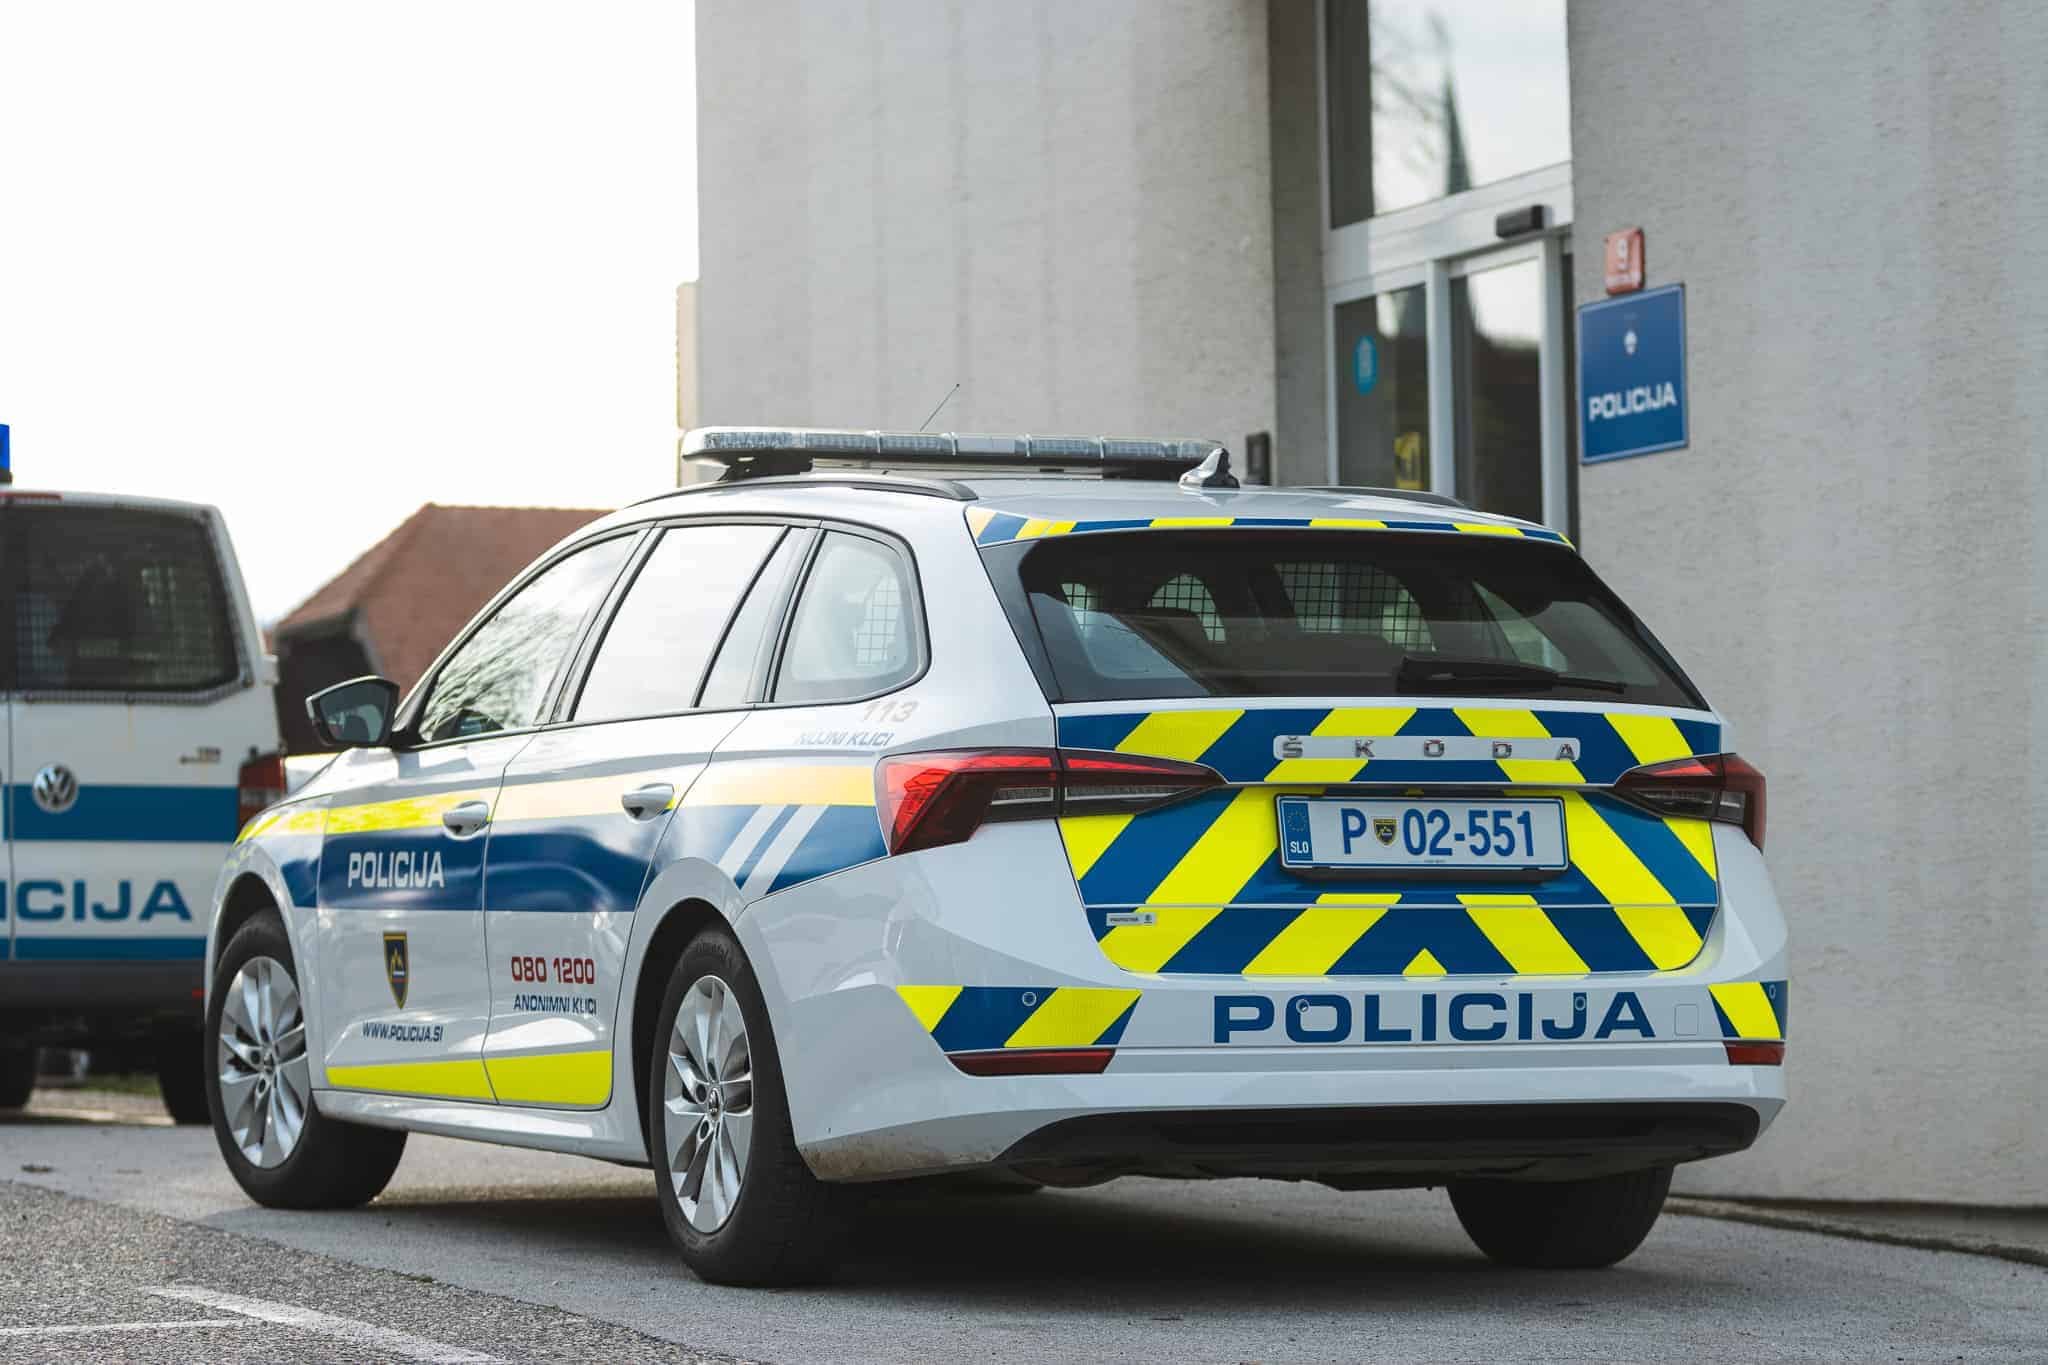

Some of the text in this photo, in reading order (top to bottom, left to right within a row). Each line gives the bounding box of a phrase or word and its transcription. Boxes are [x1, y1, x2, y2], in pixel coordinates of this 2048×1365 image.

[1588, 382, 1677, 422] POLICIJA
[863, 700, 919, 722] 113
[1281, 736, 1577, 761] ŠKODA
[1340, 808, 1534, 857] P 02-551
[1289, 840, 1309, 854] SLO
[348, 851, 445, 889] POLICIJA
[511, 956, 595, 984] 080 1200
[513, 994, 597, 1016] ANONIMNI KLICI
[1214, 992, 1655, 1043] POLICIJA
[363, 1022, 444, 1043] WWW.POLICIJA.SI
